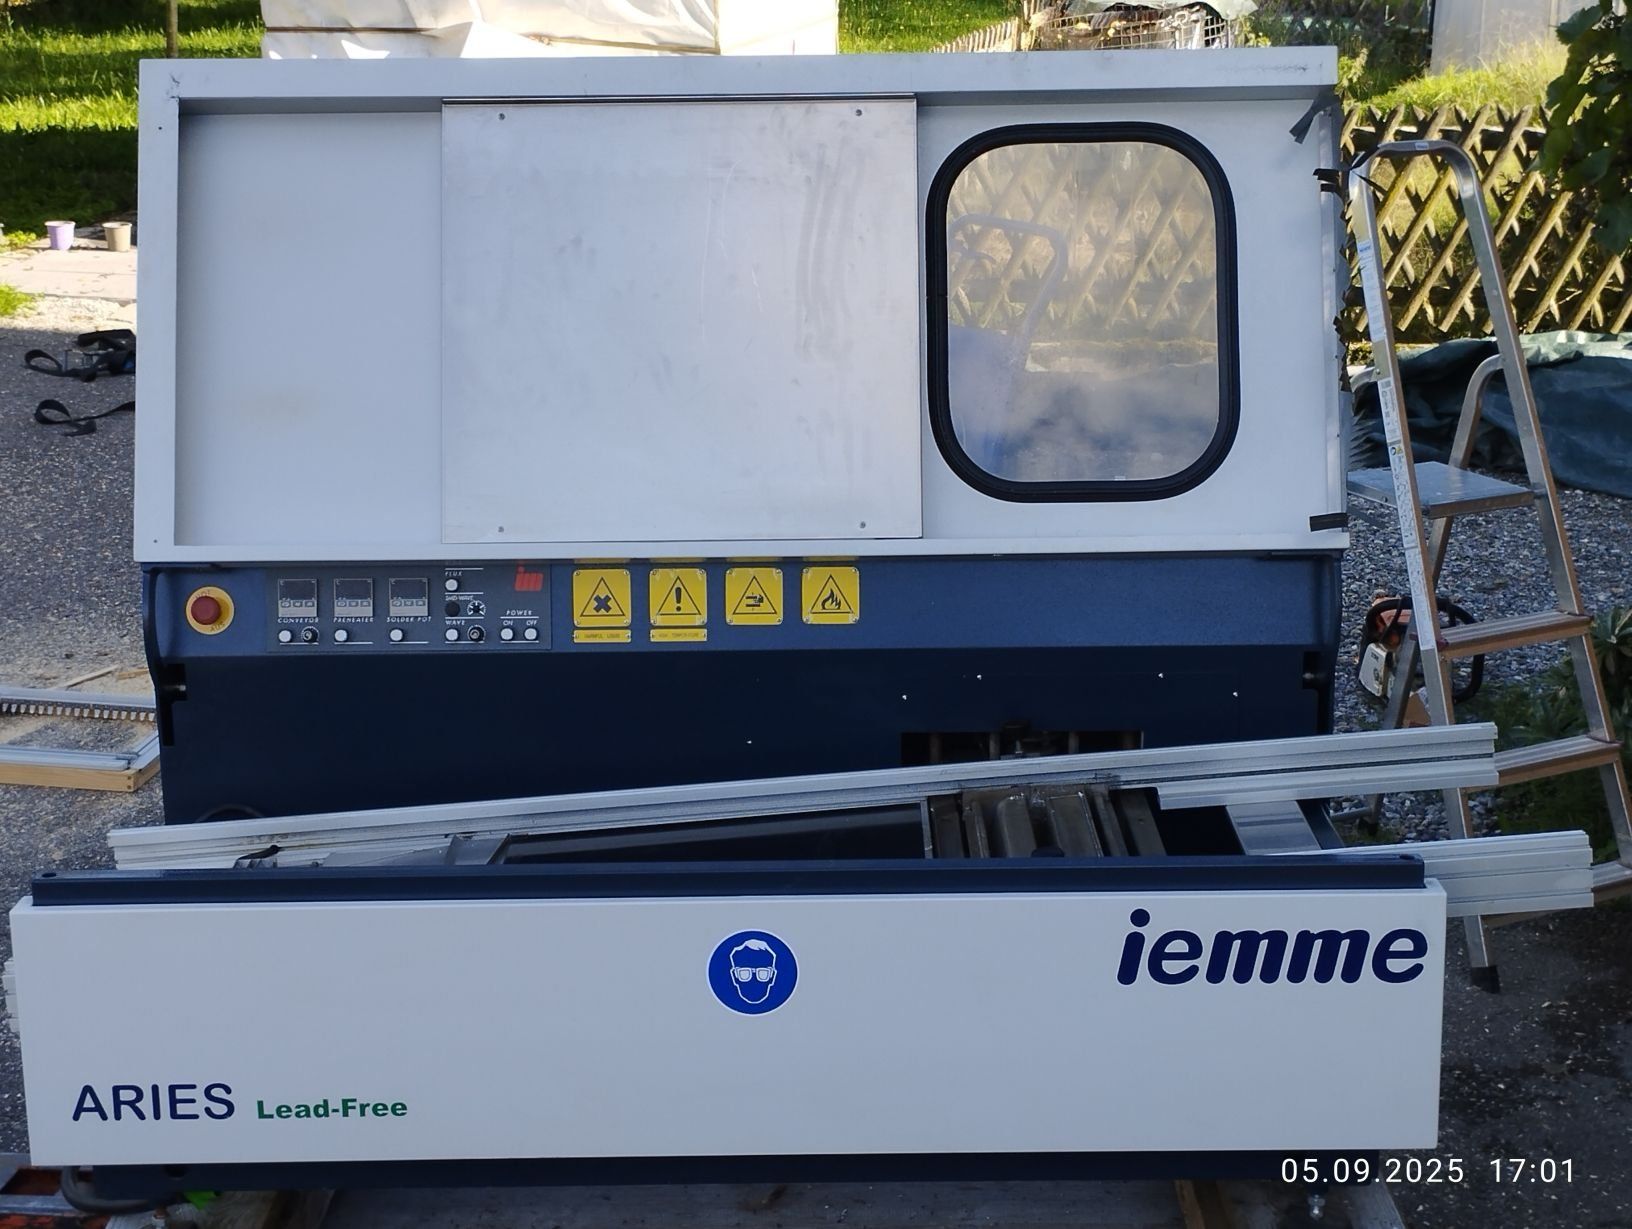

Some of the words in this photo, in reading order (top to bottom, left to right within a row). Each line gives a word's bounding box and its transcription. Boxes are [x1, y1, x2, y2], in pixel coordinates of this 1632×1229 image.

[1116, 908, 1429, 986] iemme
[72, 1082, 236, 1122] ARIES
[256, 1097, 408, 1120] Lead-Free
